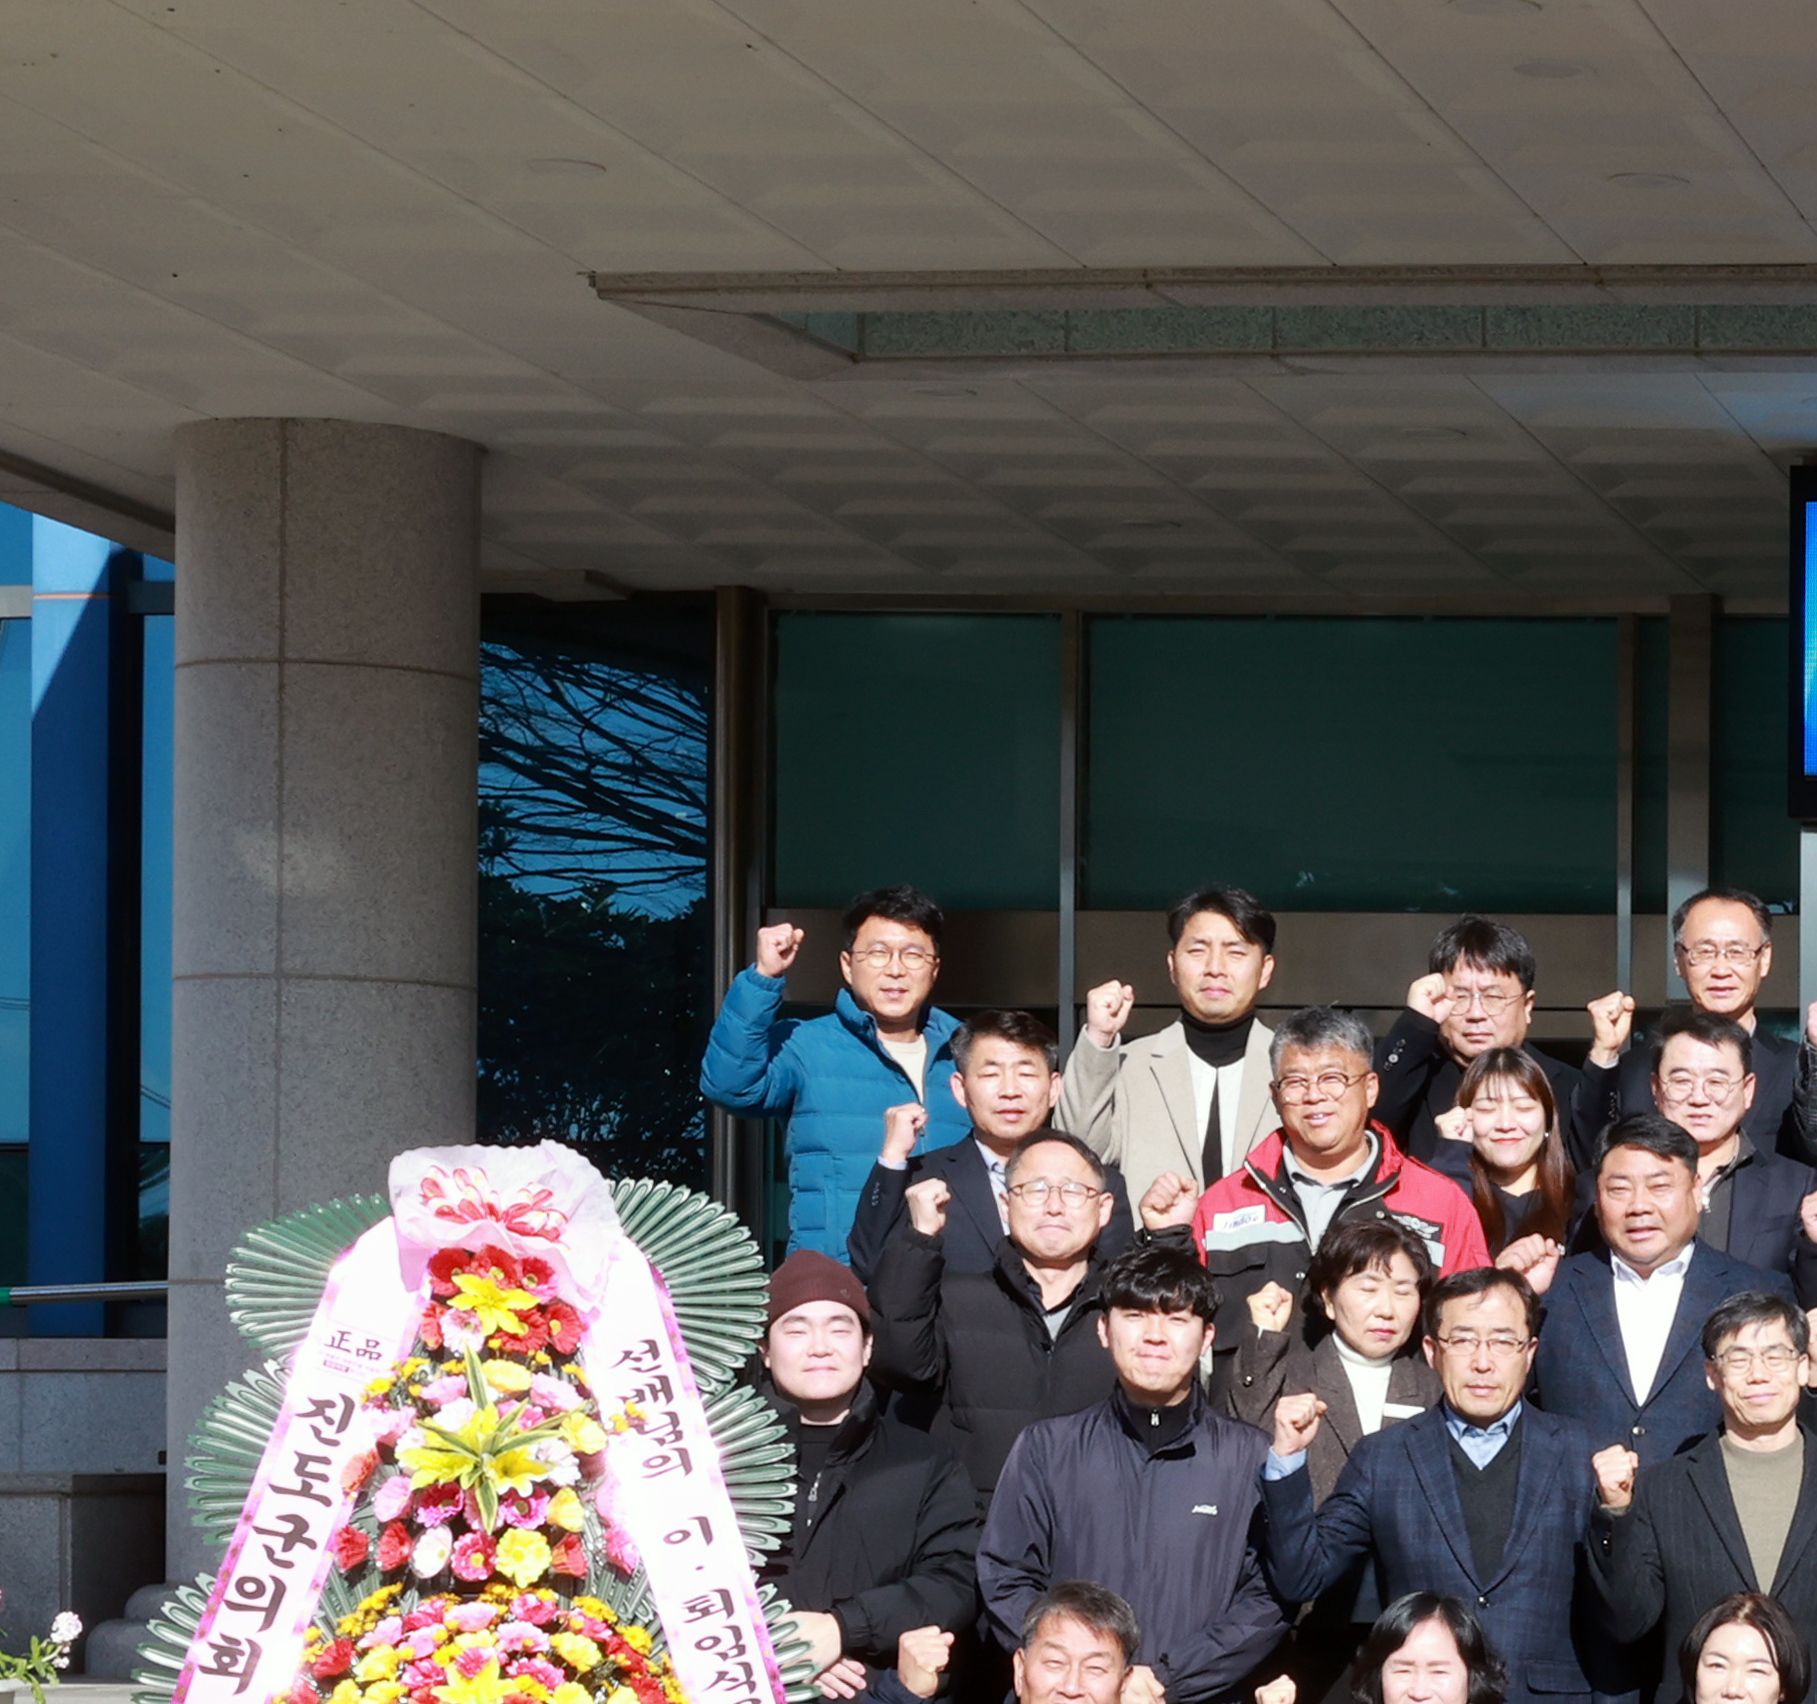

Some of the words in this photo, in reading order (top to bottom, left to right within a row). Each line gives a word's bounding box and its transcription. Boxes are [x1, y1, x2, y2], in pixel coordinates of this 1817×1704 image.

[324, 1330, 382, 1361] 正品
[198, 1393, 355, 1695] 진도군의회
[663, 1516, 713, 1546] 이
